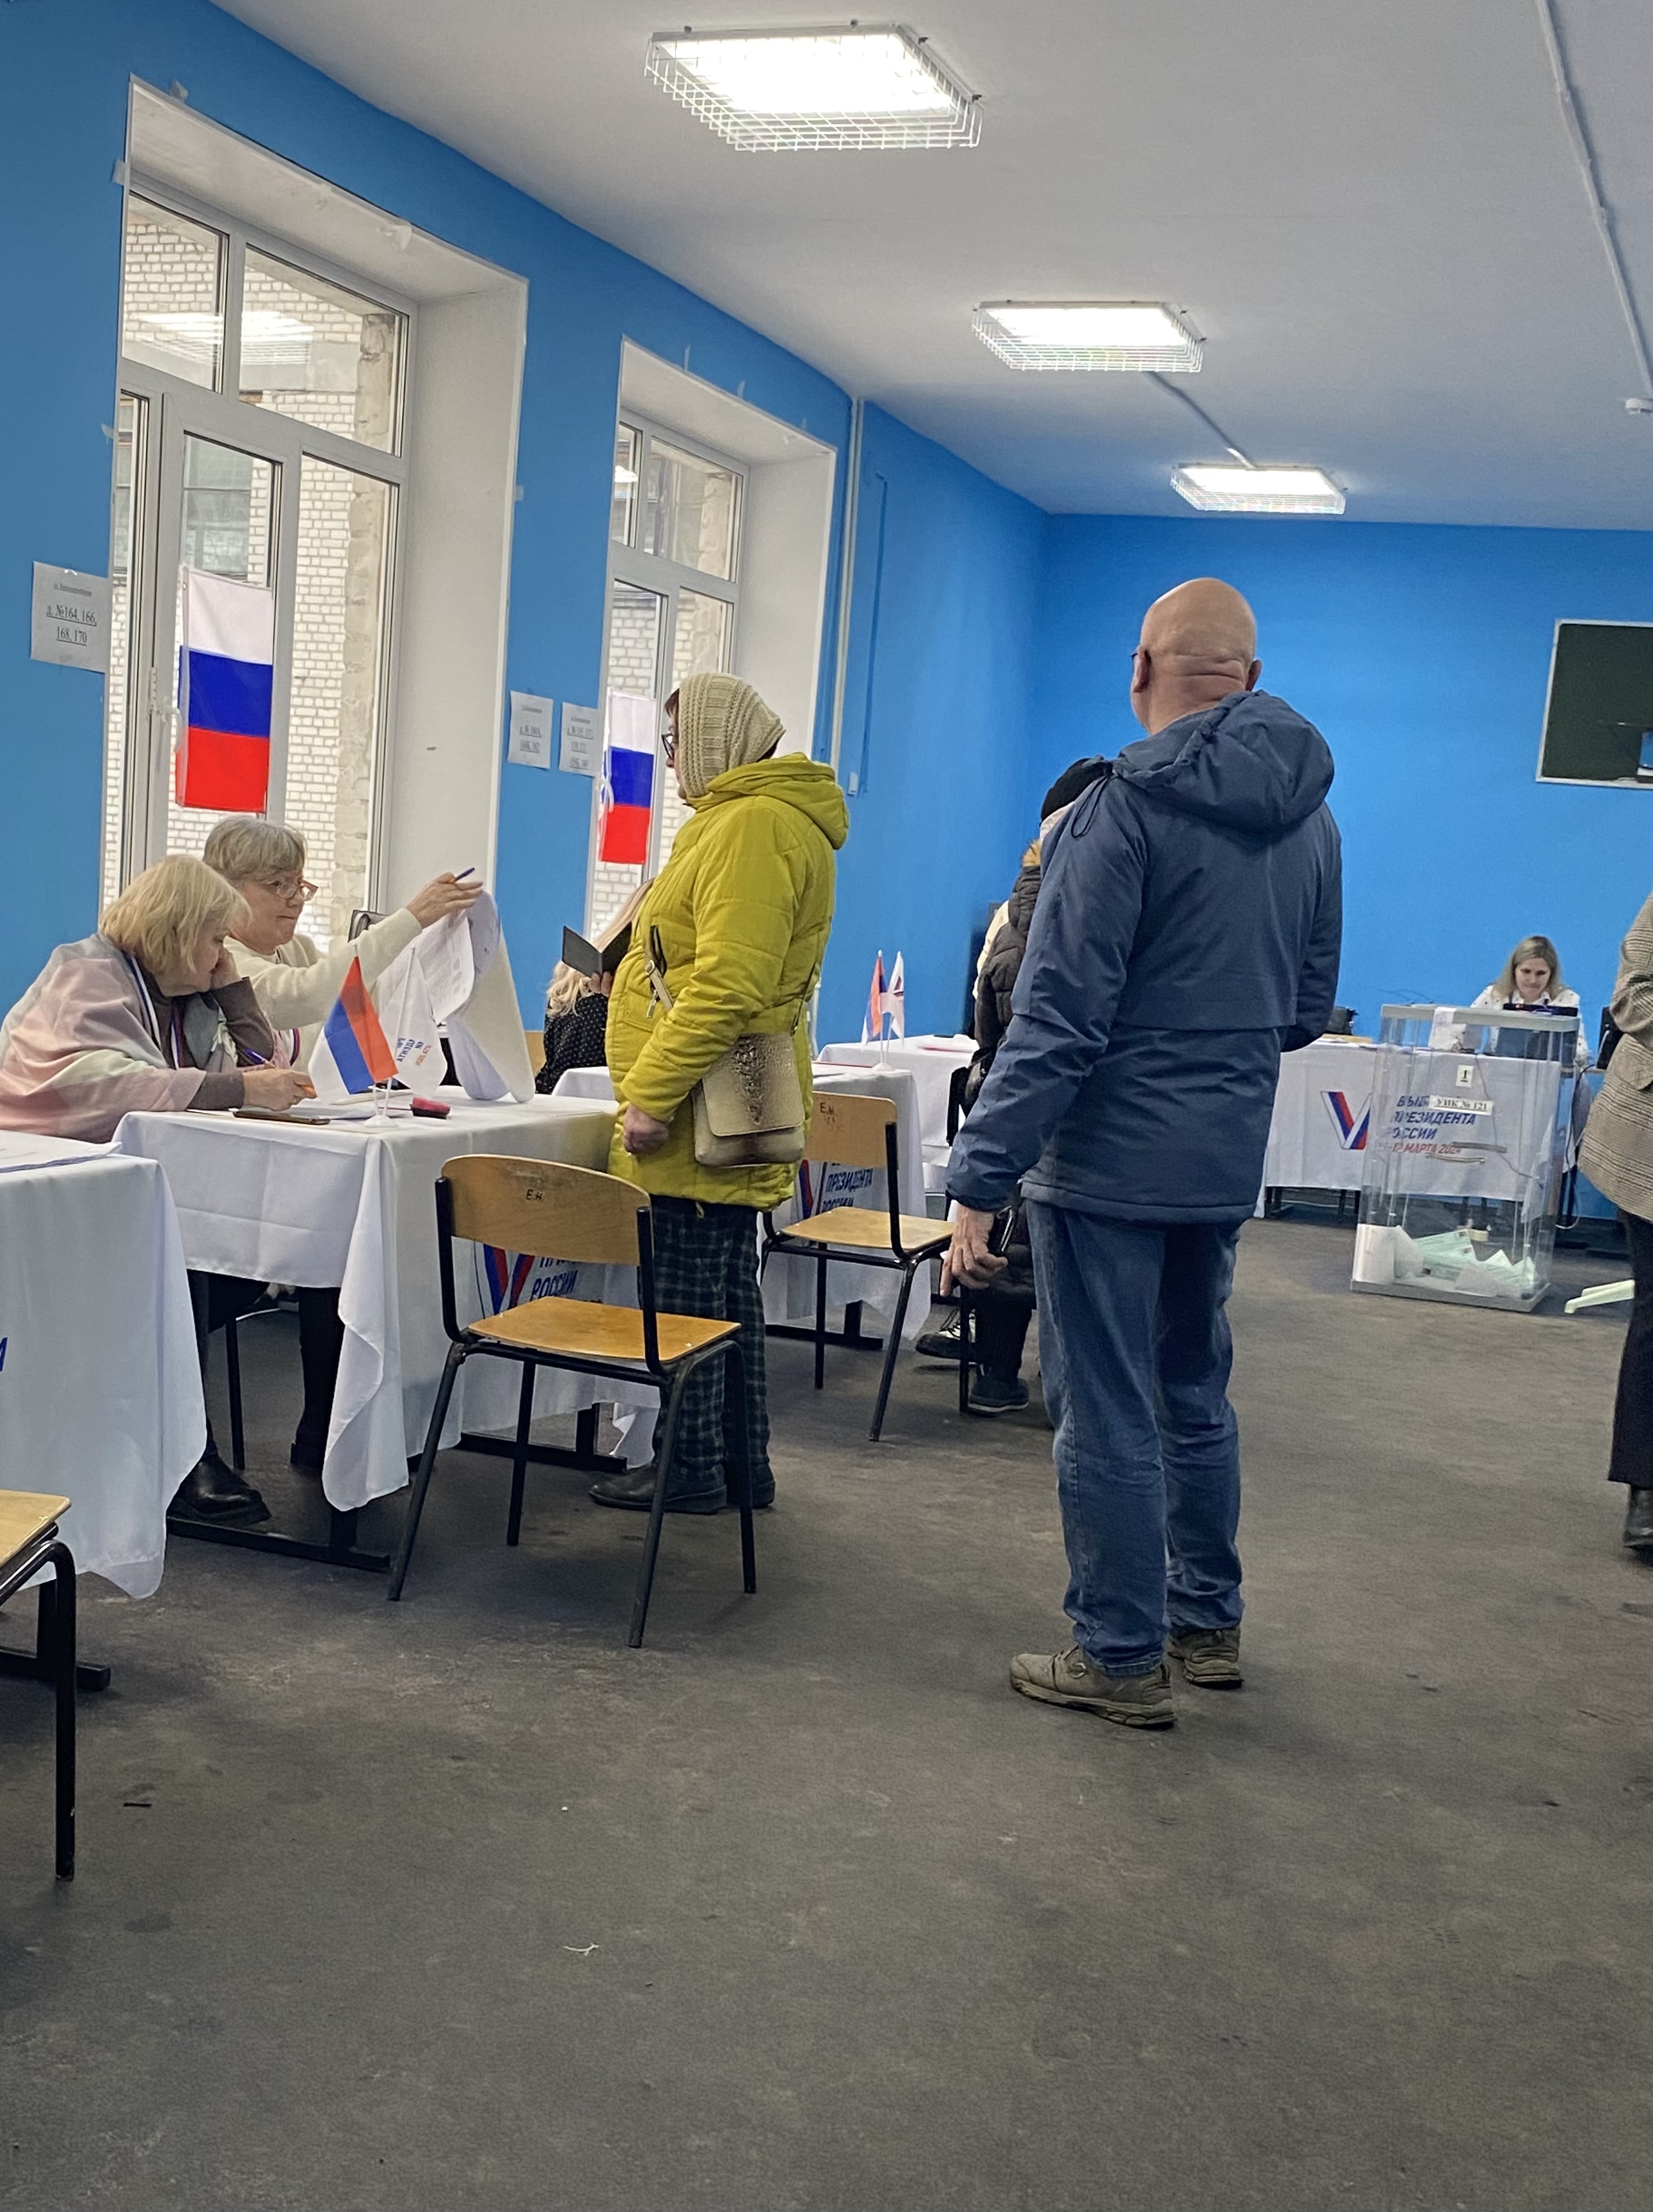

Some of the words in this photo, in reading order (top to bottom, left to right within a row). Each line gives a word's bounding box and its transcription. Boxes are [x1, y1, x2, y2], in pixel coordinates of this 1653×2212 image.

[75, 630, 87, 643] 170
[1463, 1070, 1468, 1079] 1
[1437, 1099, 1459, 1108] УИК
[1474, 1102, 1487, 1111] 121
[1392, 1127, 1438, 1139] ОССИИ
[529, 1269, 578, 1302] РОССИИ
